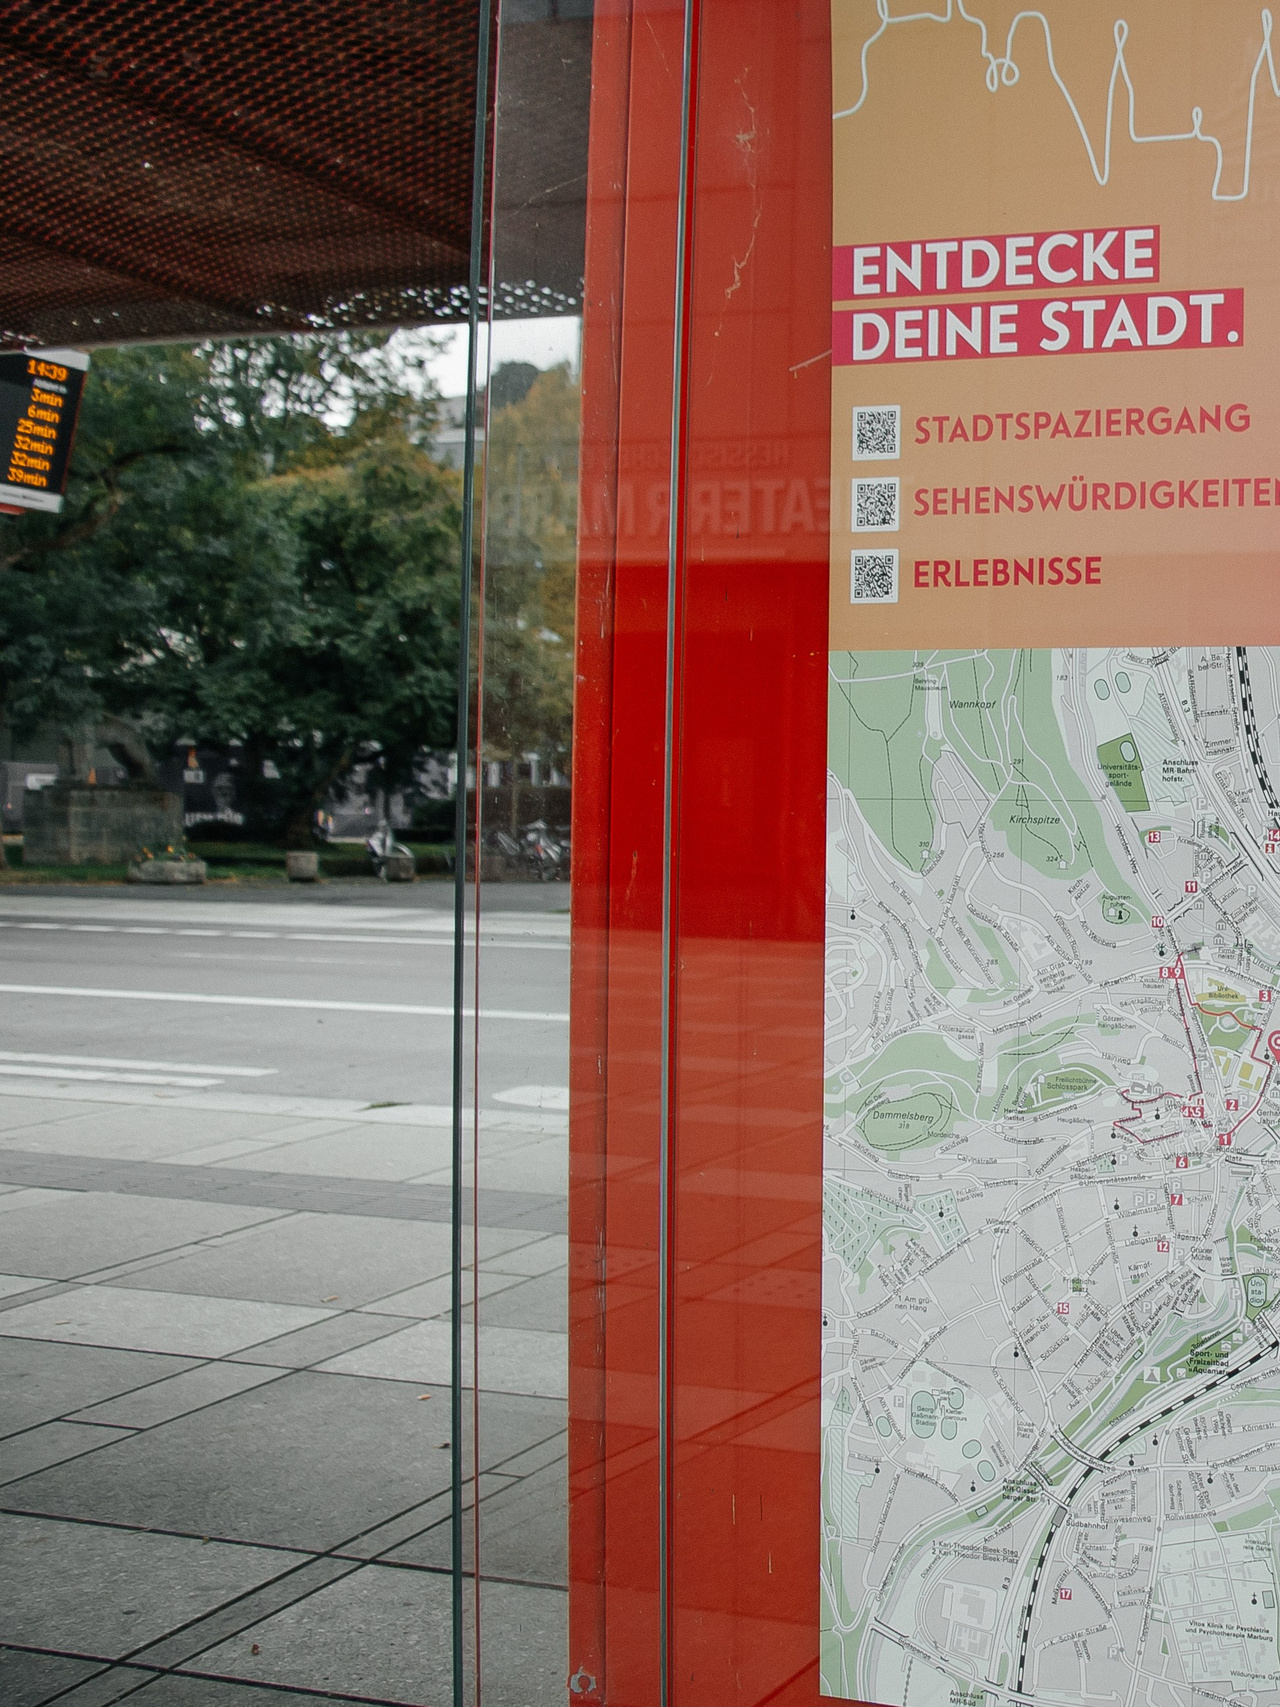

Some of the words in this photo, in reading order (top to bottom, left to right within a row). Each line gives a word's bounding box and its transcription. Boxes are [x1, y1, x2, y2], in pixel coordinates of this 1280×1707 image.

[853, 228, 1154, 295] ENTDECKE
[852, 305, 1018, 361] DEINE
[1039, 293, 1238, 351] STADT.
[27, 359, 68, 382] 14:39
[914, 403, 1251, 445] STADTSPAZIERGANG
[913, 557, 1101, 587] ERLEBNISSE
[950, 700, 996, 709] Wannkopf
[1009, 815, 1060, 825] Kirchspitze
[1150, 832, 1160, 842] 13
[1270, 830, 1280, 840] 14
[1186, 882, 1196, 892] 11
[1153, 917, 1164, 927] 10
[1262, 991, 1269, 1001] 3
[1047, 1082, 1088, 1091] Schlosspark
[1229, 1100, 1235, 1110] 2
[873, 1110, 934, 1123] Dammelsberg
[1223, 1135, 1228, 1145] 1
[1179, 1158, 1185, 1167] 6
[1173, 1196, 1180, 1205] 7
[1158, 1242, 1168, 1251] 12
[1058, 1303, 1068, 1313] 15
[1066, 1520, 1108, 1530] Südbahnhof
[1061, 1589, 1071, 1599] 17
